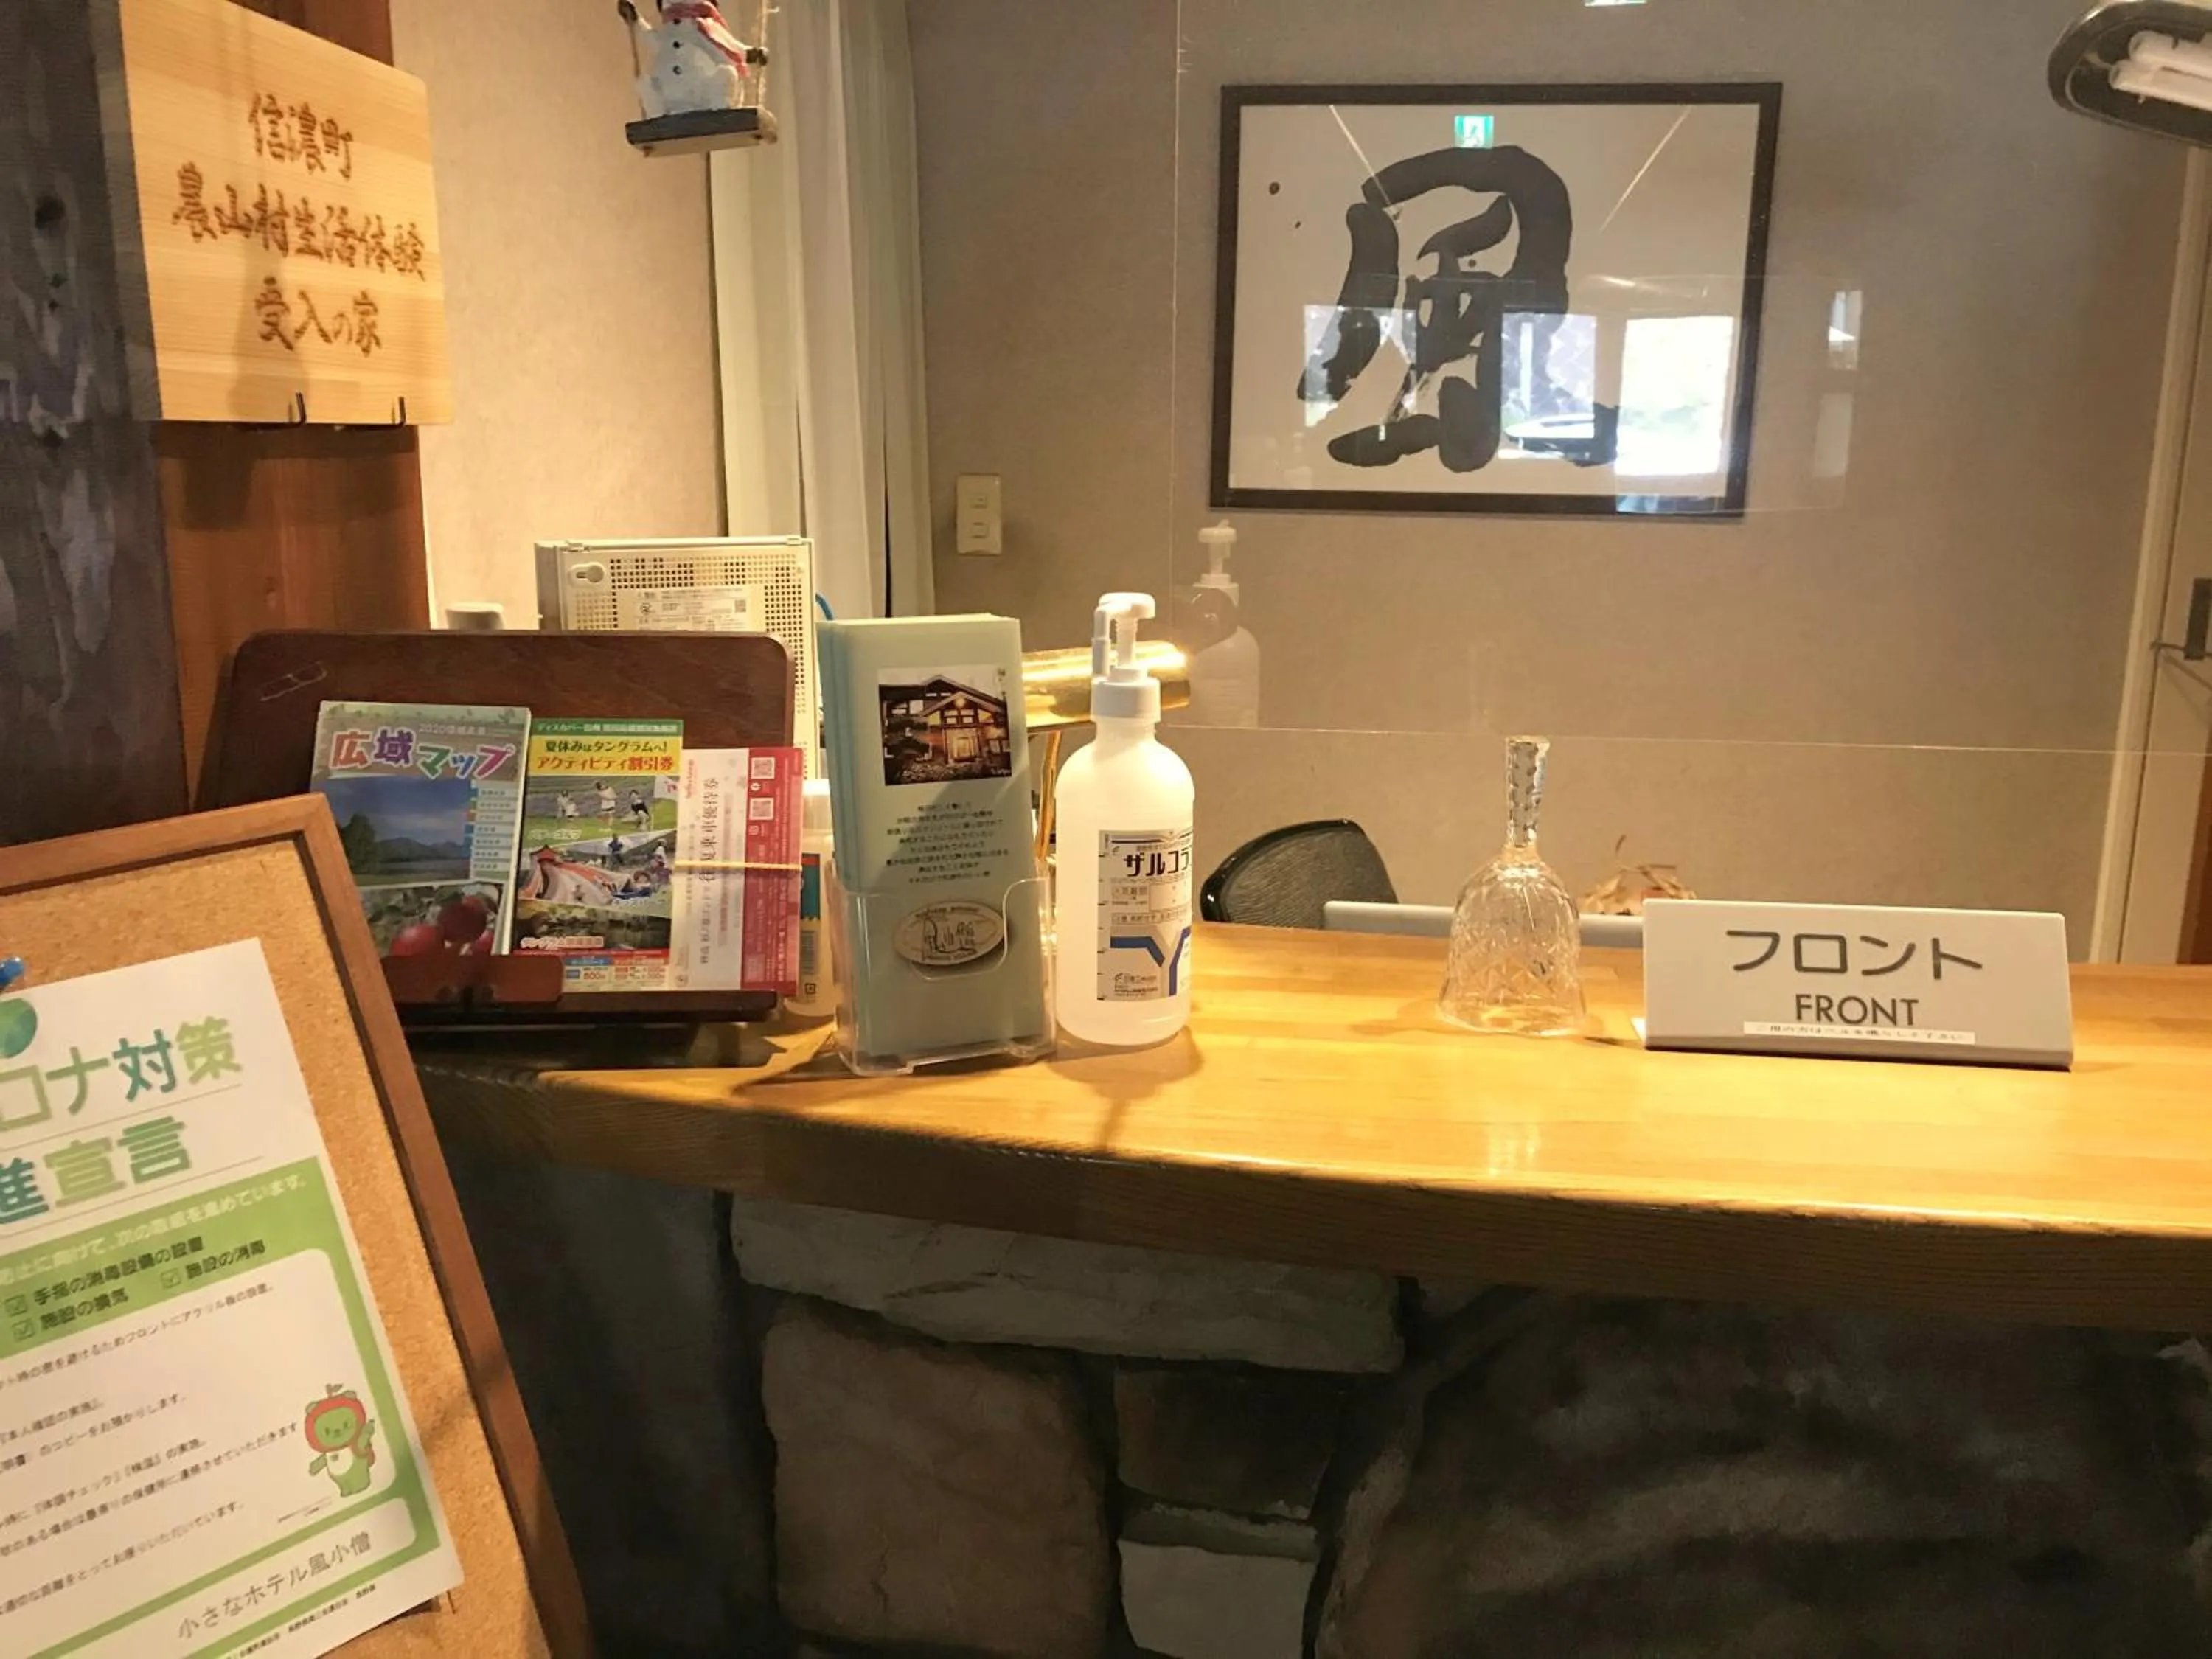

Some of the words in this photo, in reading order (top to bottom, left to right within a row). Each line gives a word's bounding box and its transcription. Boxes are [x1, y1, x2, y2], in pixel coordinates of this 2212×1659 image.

[248, 92, 354, 182] 信濃町
[254, 275, 382, 358] 受入の家
[329, 726, 516, 779] 広域マップ
[537, 756, 675, 771] アクティビティ割引券
[1725, 930, 1983, 980] フロント
[1795, 993, 1920, 1026] FRONT
[0, 1015, 243, 1133] ロナ対策
[0, 1116, 192, 1225] 進宣言
[178, 1531, 372, 1641] 小さなホテル風小僧
